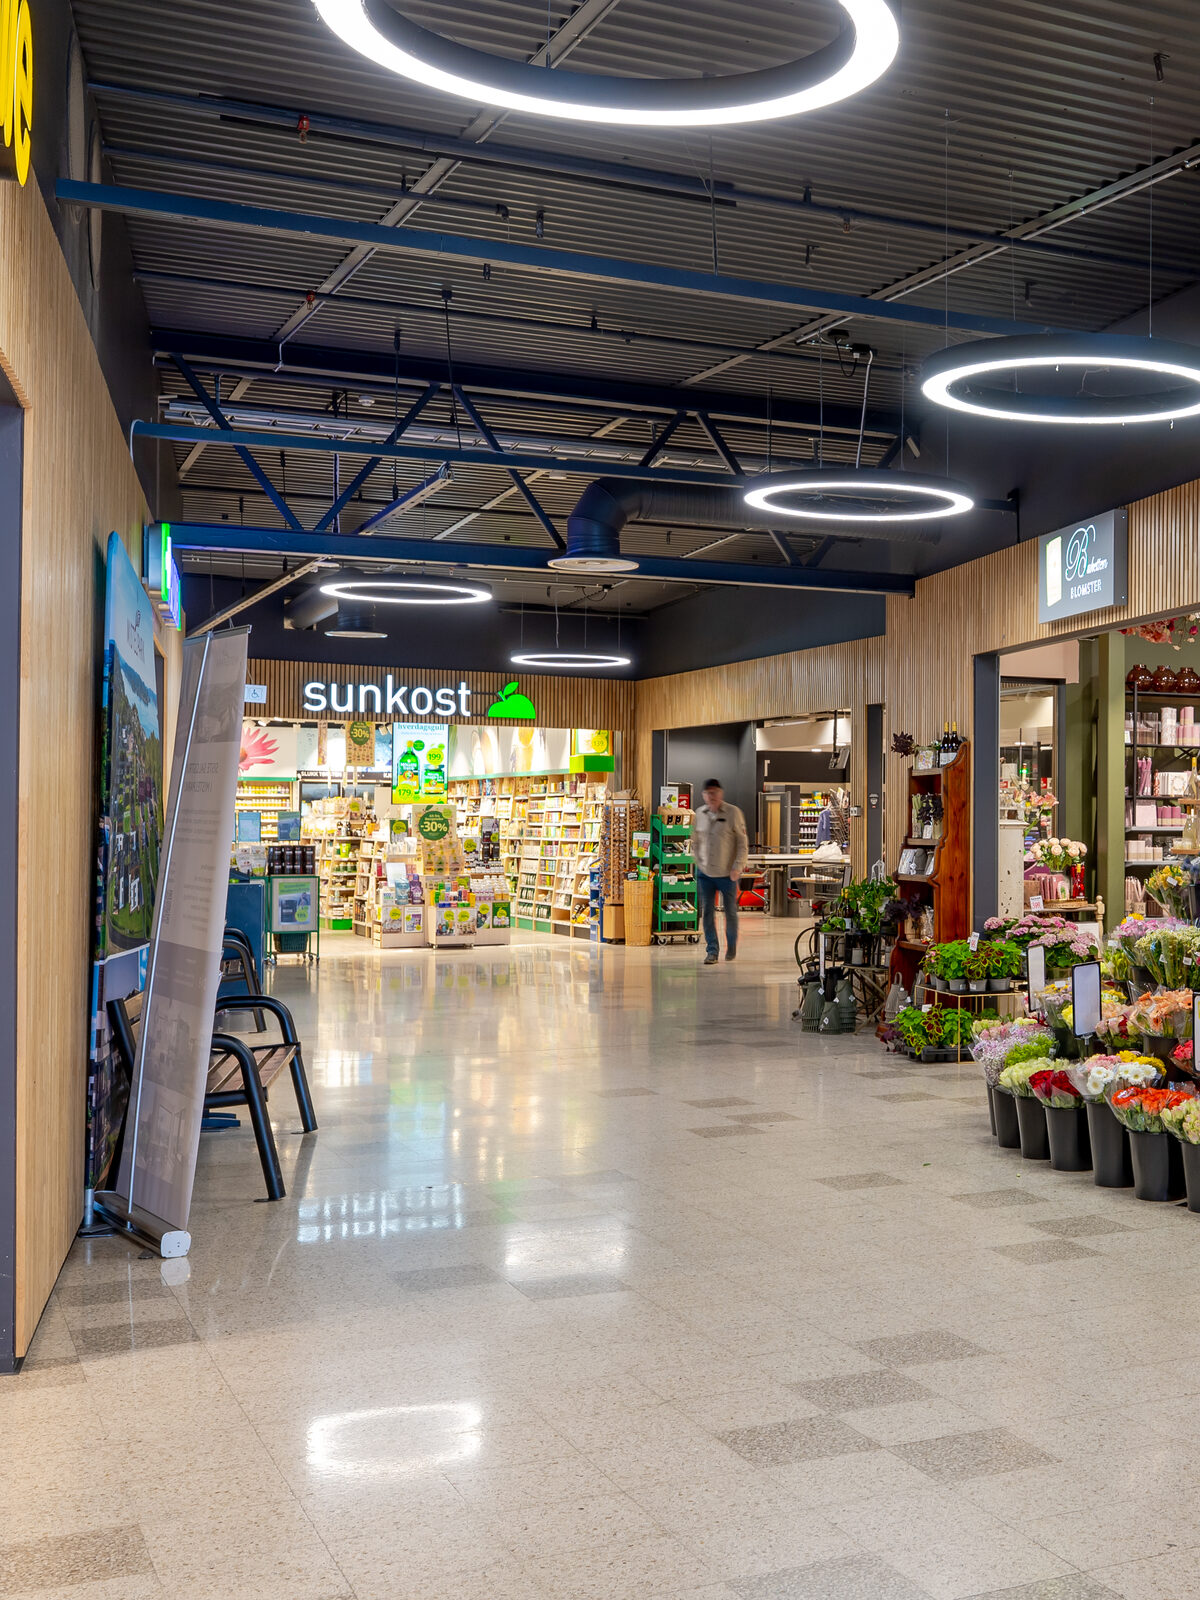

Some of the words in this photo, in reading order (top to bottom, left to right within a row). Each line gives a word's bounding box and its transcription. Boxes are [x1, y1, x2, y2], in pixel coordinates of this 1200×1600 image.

[1070, 579, 1102, 600] BLOMSTER
[303, 674, 471, 718] sunkost
[351, 728, 370, 738] -30%
[420, 820, 448, 833] -30%
